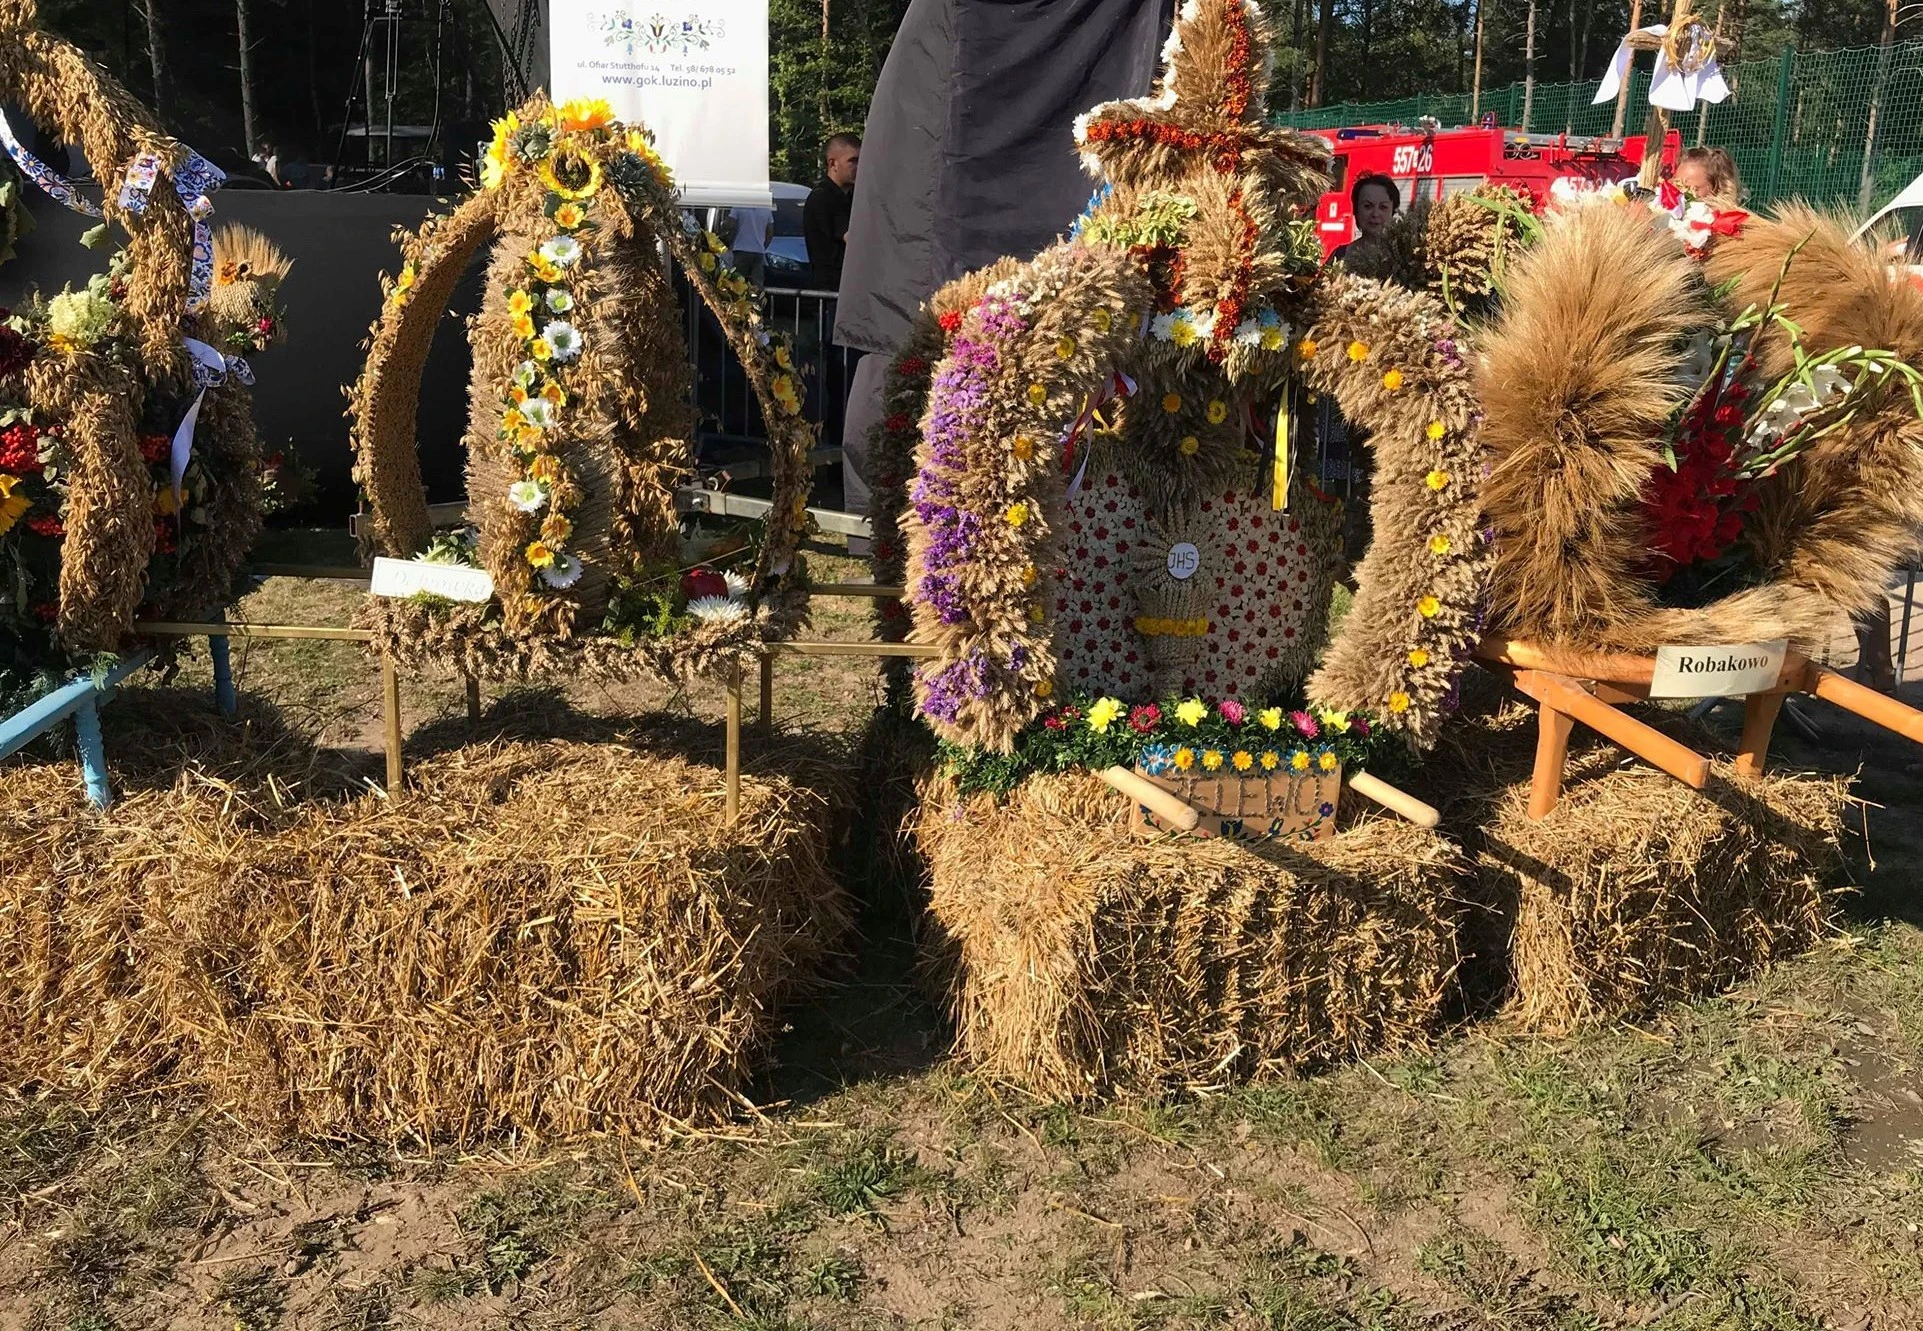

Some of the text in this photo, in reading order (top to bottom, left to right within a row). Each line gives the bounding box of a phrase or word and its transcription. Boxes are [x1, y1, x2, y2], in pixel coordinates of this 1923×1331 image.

[589, 61, 609, 69] Ofiar
[611, 62, 649, 71] Stutthofu
[602, 75, 712, 90] www.gok.luzino.pl
[1168, 551, 1195, 570] JHS
[1679, 655, 1769, 673] Robakowo
